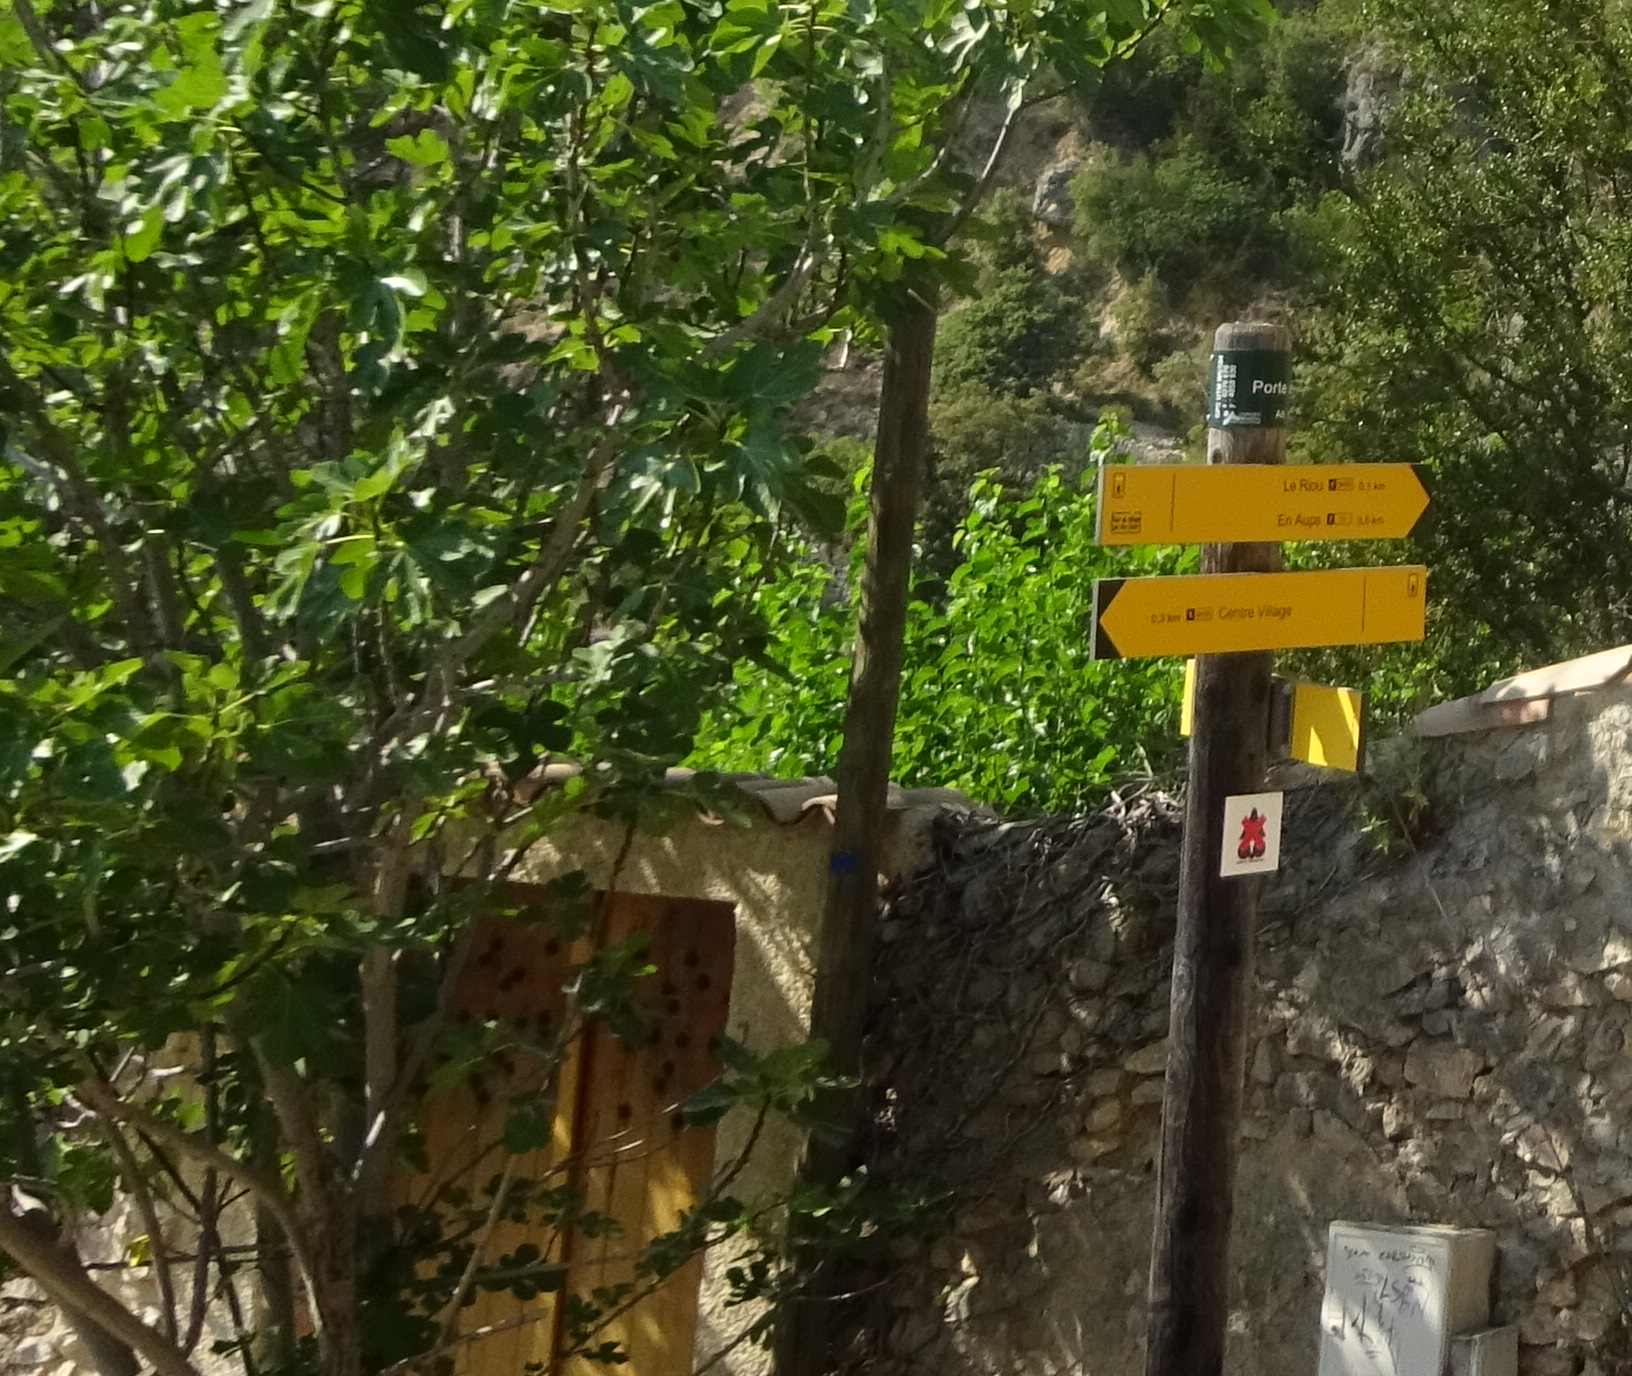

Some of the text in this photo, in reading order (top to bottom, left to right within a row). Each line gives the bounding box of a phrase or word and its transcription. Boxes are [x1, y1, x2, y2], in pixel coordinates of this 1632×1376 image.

[1252, 379, 1287, 394] Porte
[1283, 479, 1297, 492] Le
[1277, 513, 1292, 527] En
[1218, 605, 1255, 620] Centre
[1256, 603, 1293, 620] Village
